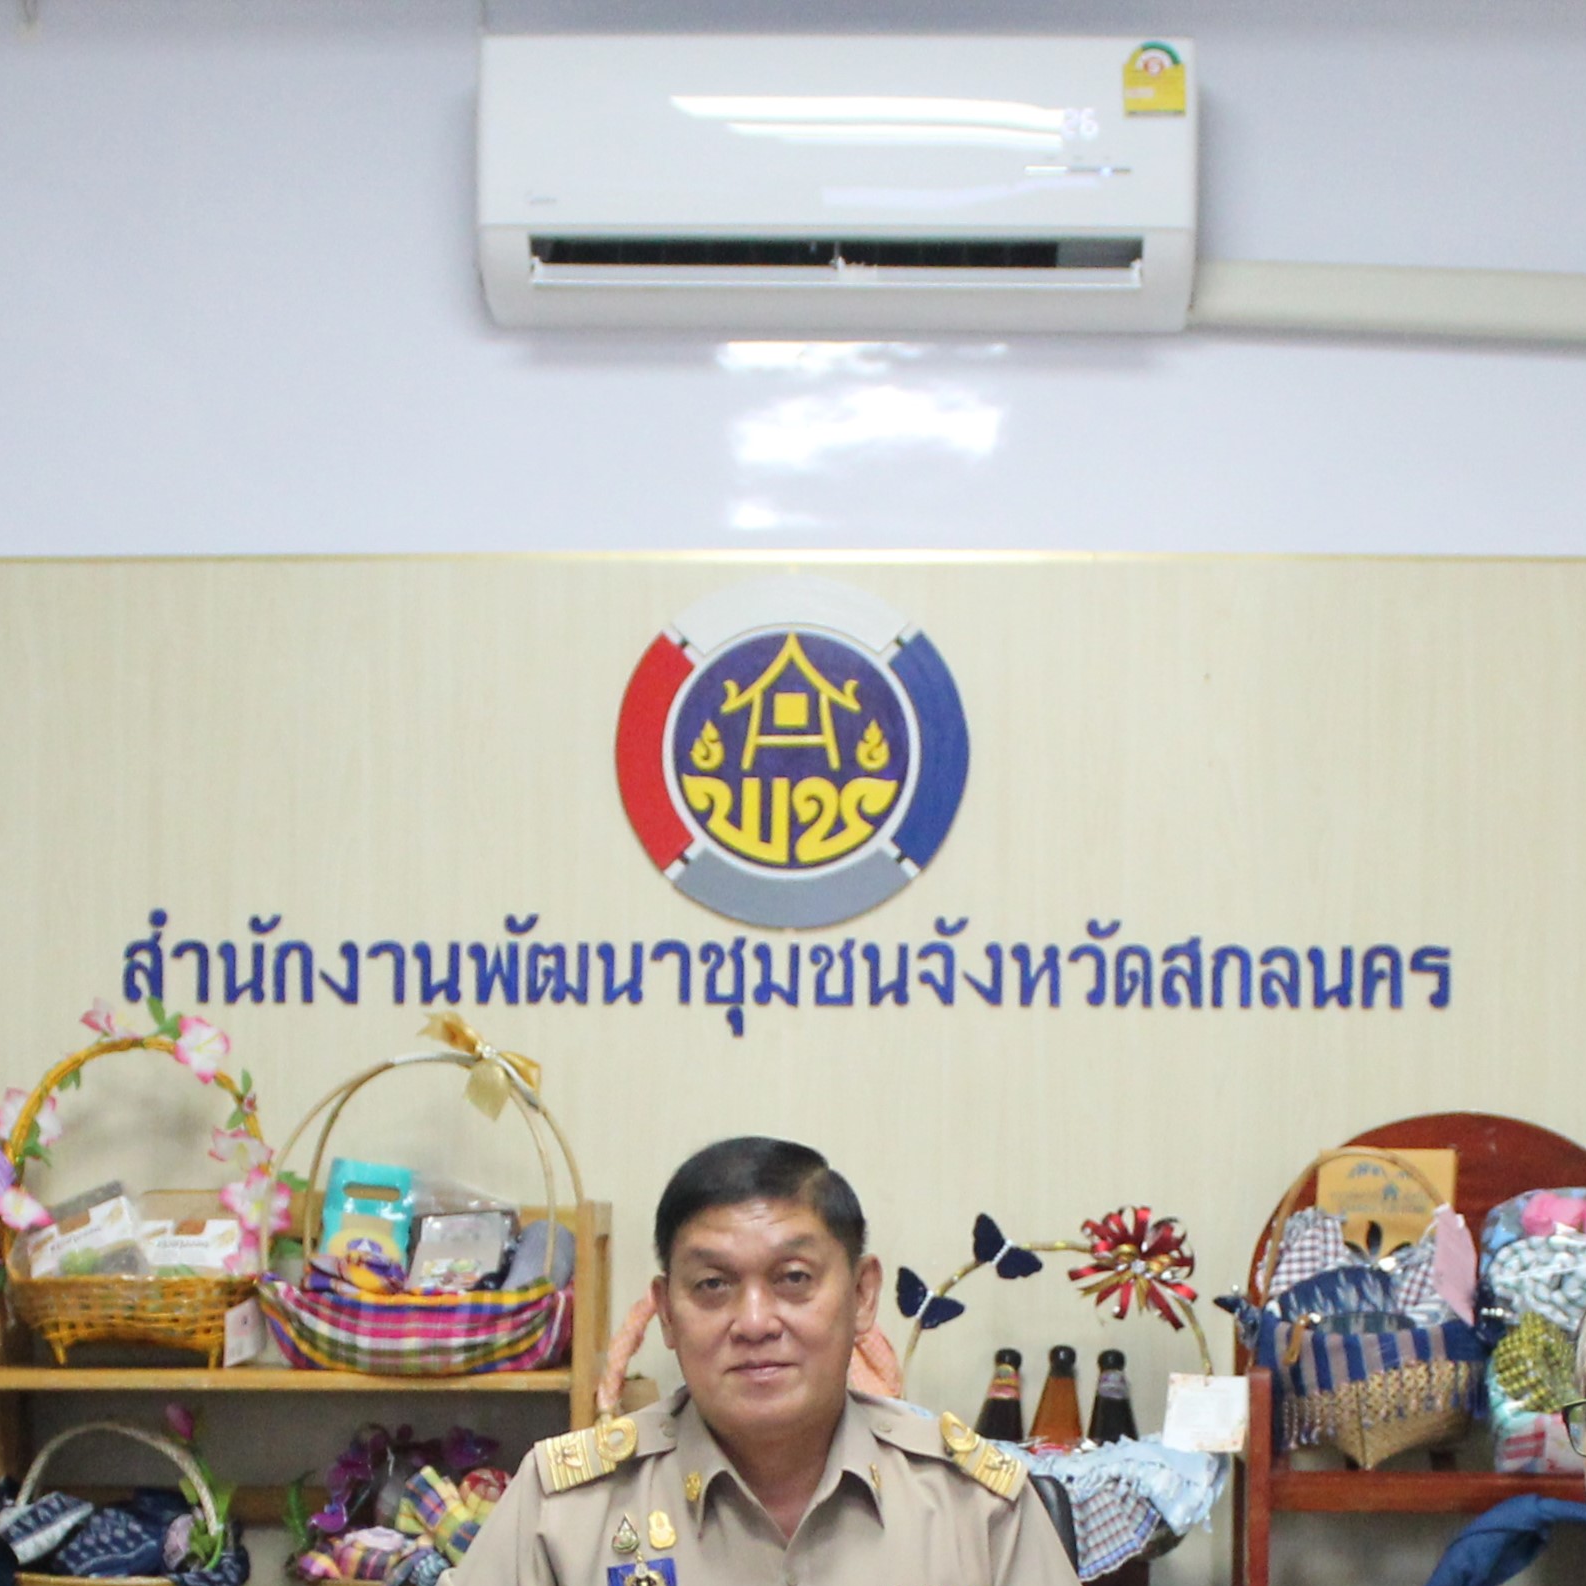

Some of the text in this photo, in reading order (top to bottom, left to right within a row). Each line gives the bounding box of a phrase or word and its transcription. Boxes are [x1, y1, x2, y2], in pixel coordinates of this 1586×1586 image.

[122, 909, 1451, 1036] สำนักงานพัฒนาชุมชนจังหวัดสกลนคร
